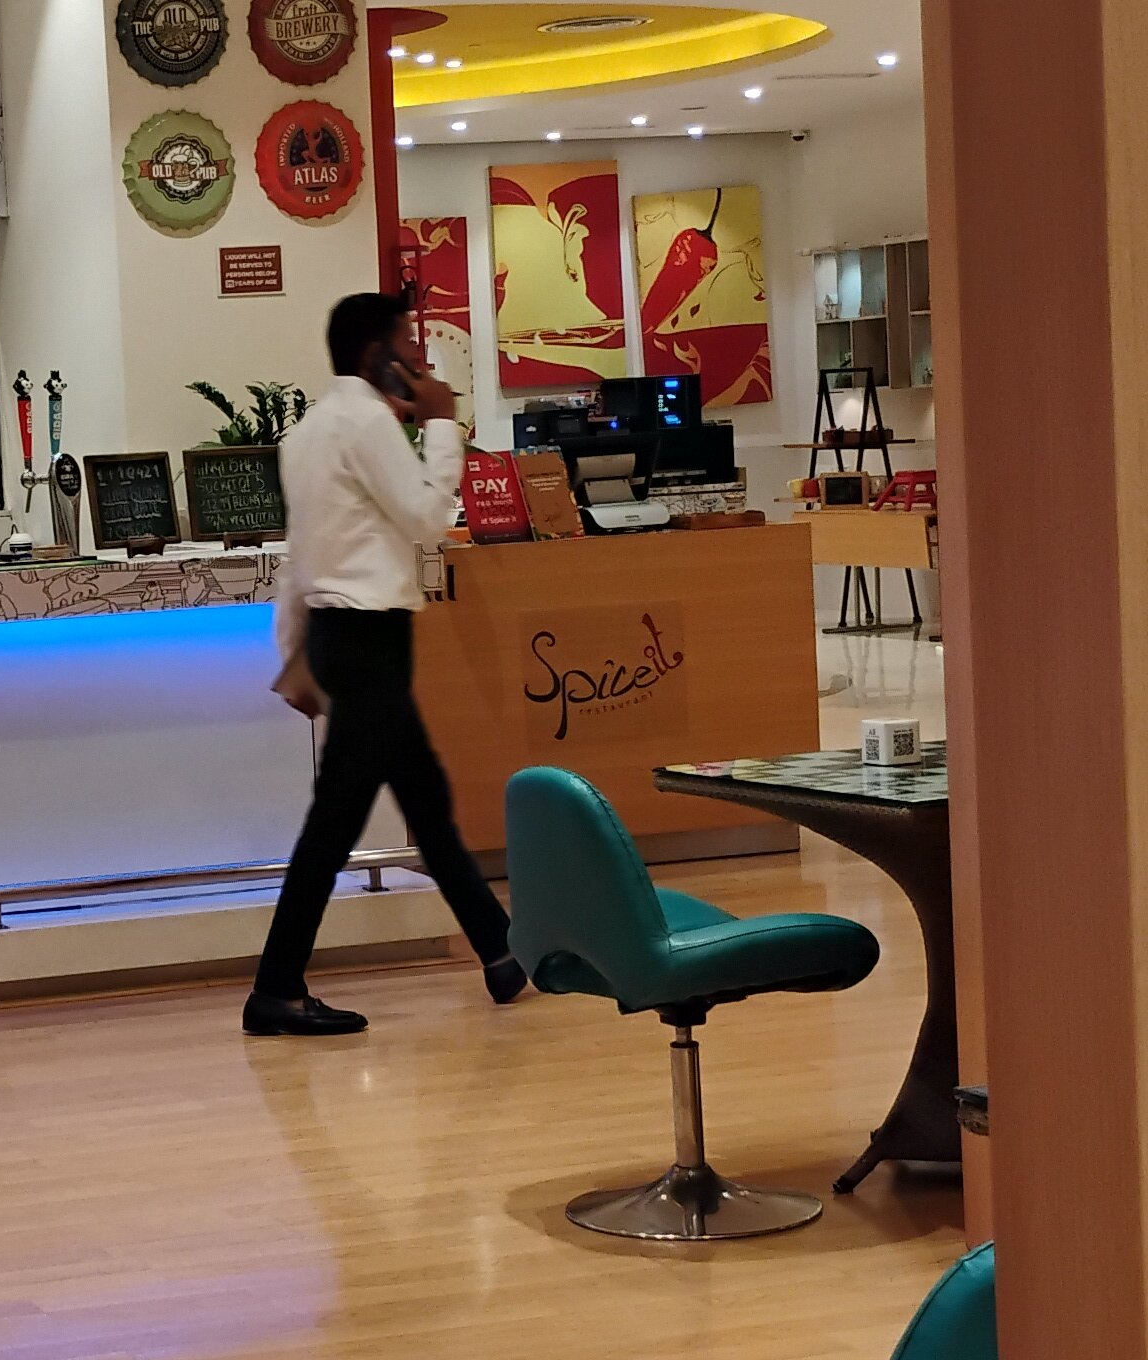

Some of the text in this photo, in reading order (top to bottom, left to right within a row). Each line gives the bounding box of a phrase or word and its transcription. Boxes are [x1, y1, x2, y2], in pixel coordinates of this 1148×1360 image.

[133, 18, 220, 35] THE PUB
[275, 15, 339, 38] BREWERY
[279, 123, 296, 167] IMPORTED
[333, 124, 350, 163] HOLLAND
[152, 164, 218, 180] OLD PUB
[294, 166, 338, 185] ATLAS
[305, 194, 331, 204] BEER
[471, 478, 508, 494] PAY
[579, 690, 653, 715] restaurant
